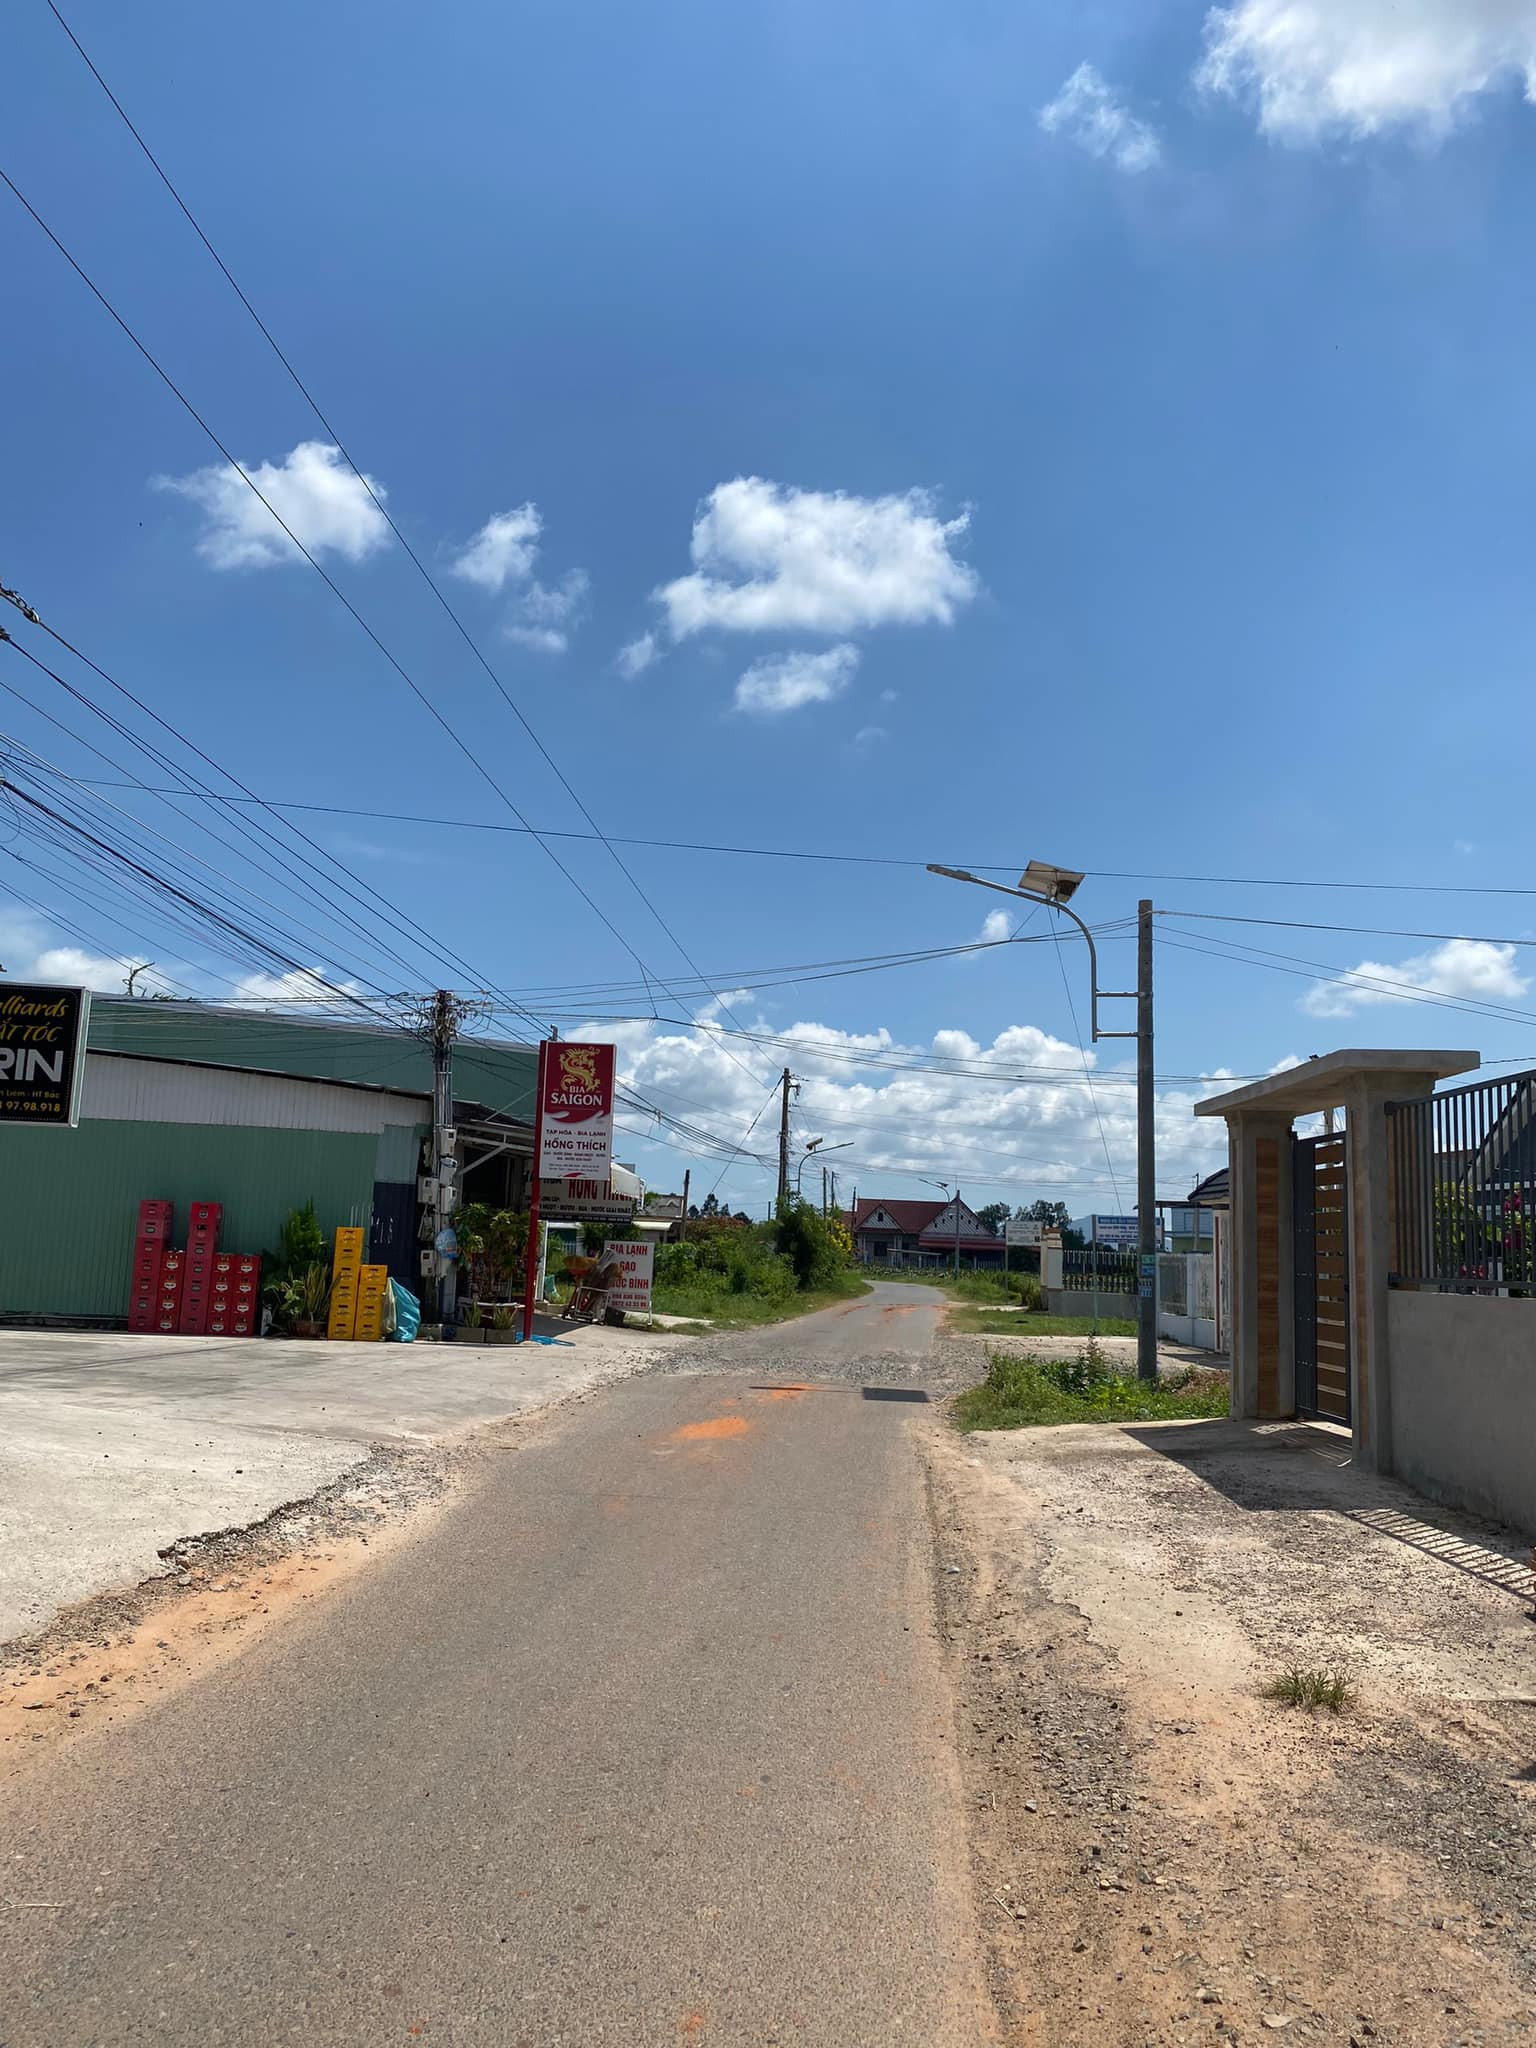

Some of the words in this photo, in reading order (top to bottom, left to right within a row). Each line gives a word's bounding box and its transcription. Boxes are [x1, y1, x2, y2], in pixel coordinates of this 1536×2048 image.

[569, 1085, 585, 1094] BIA
[551, 1092, 603, 1106] SAIGON
[576, 1138, 606, 1151] THÍCH
